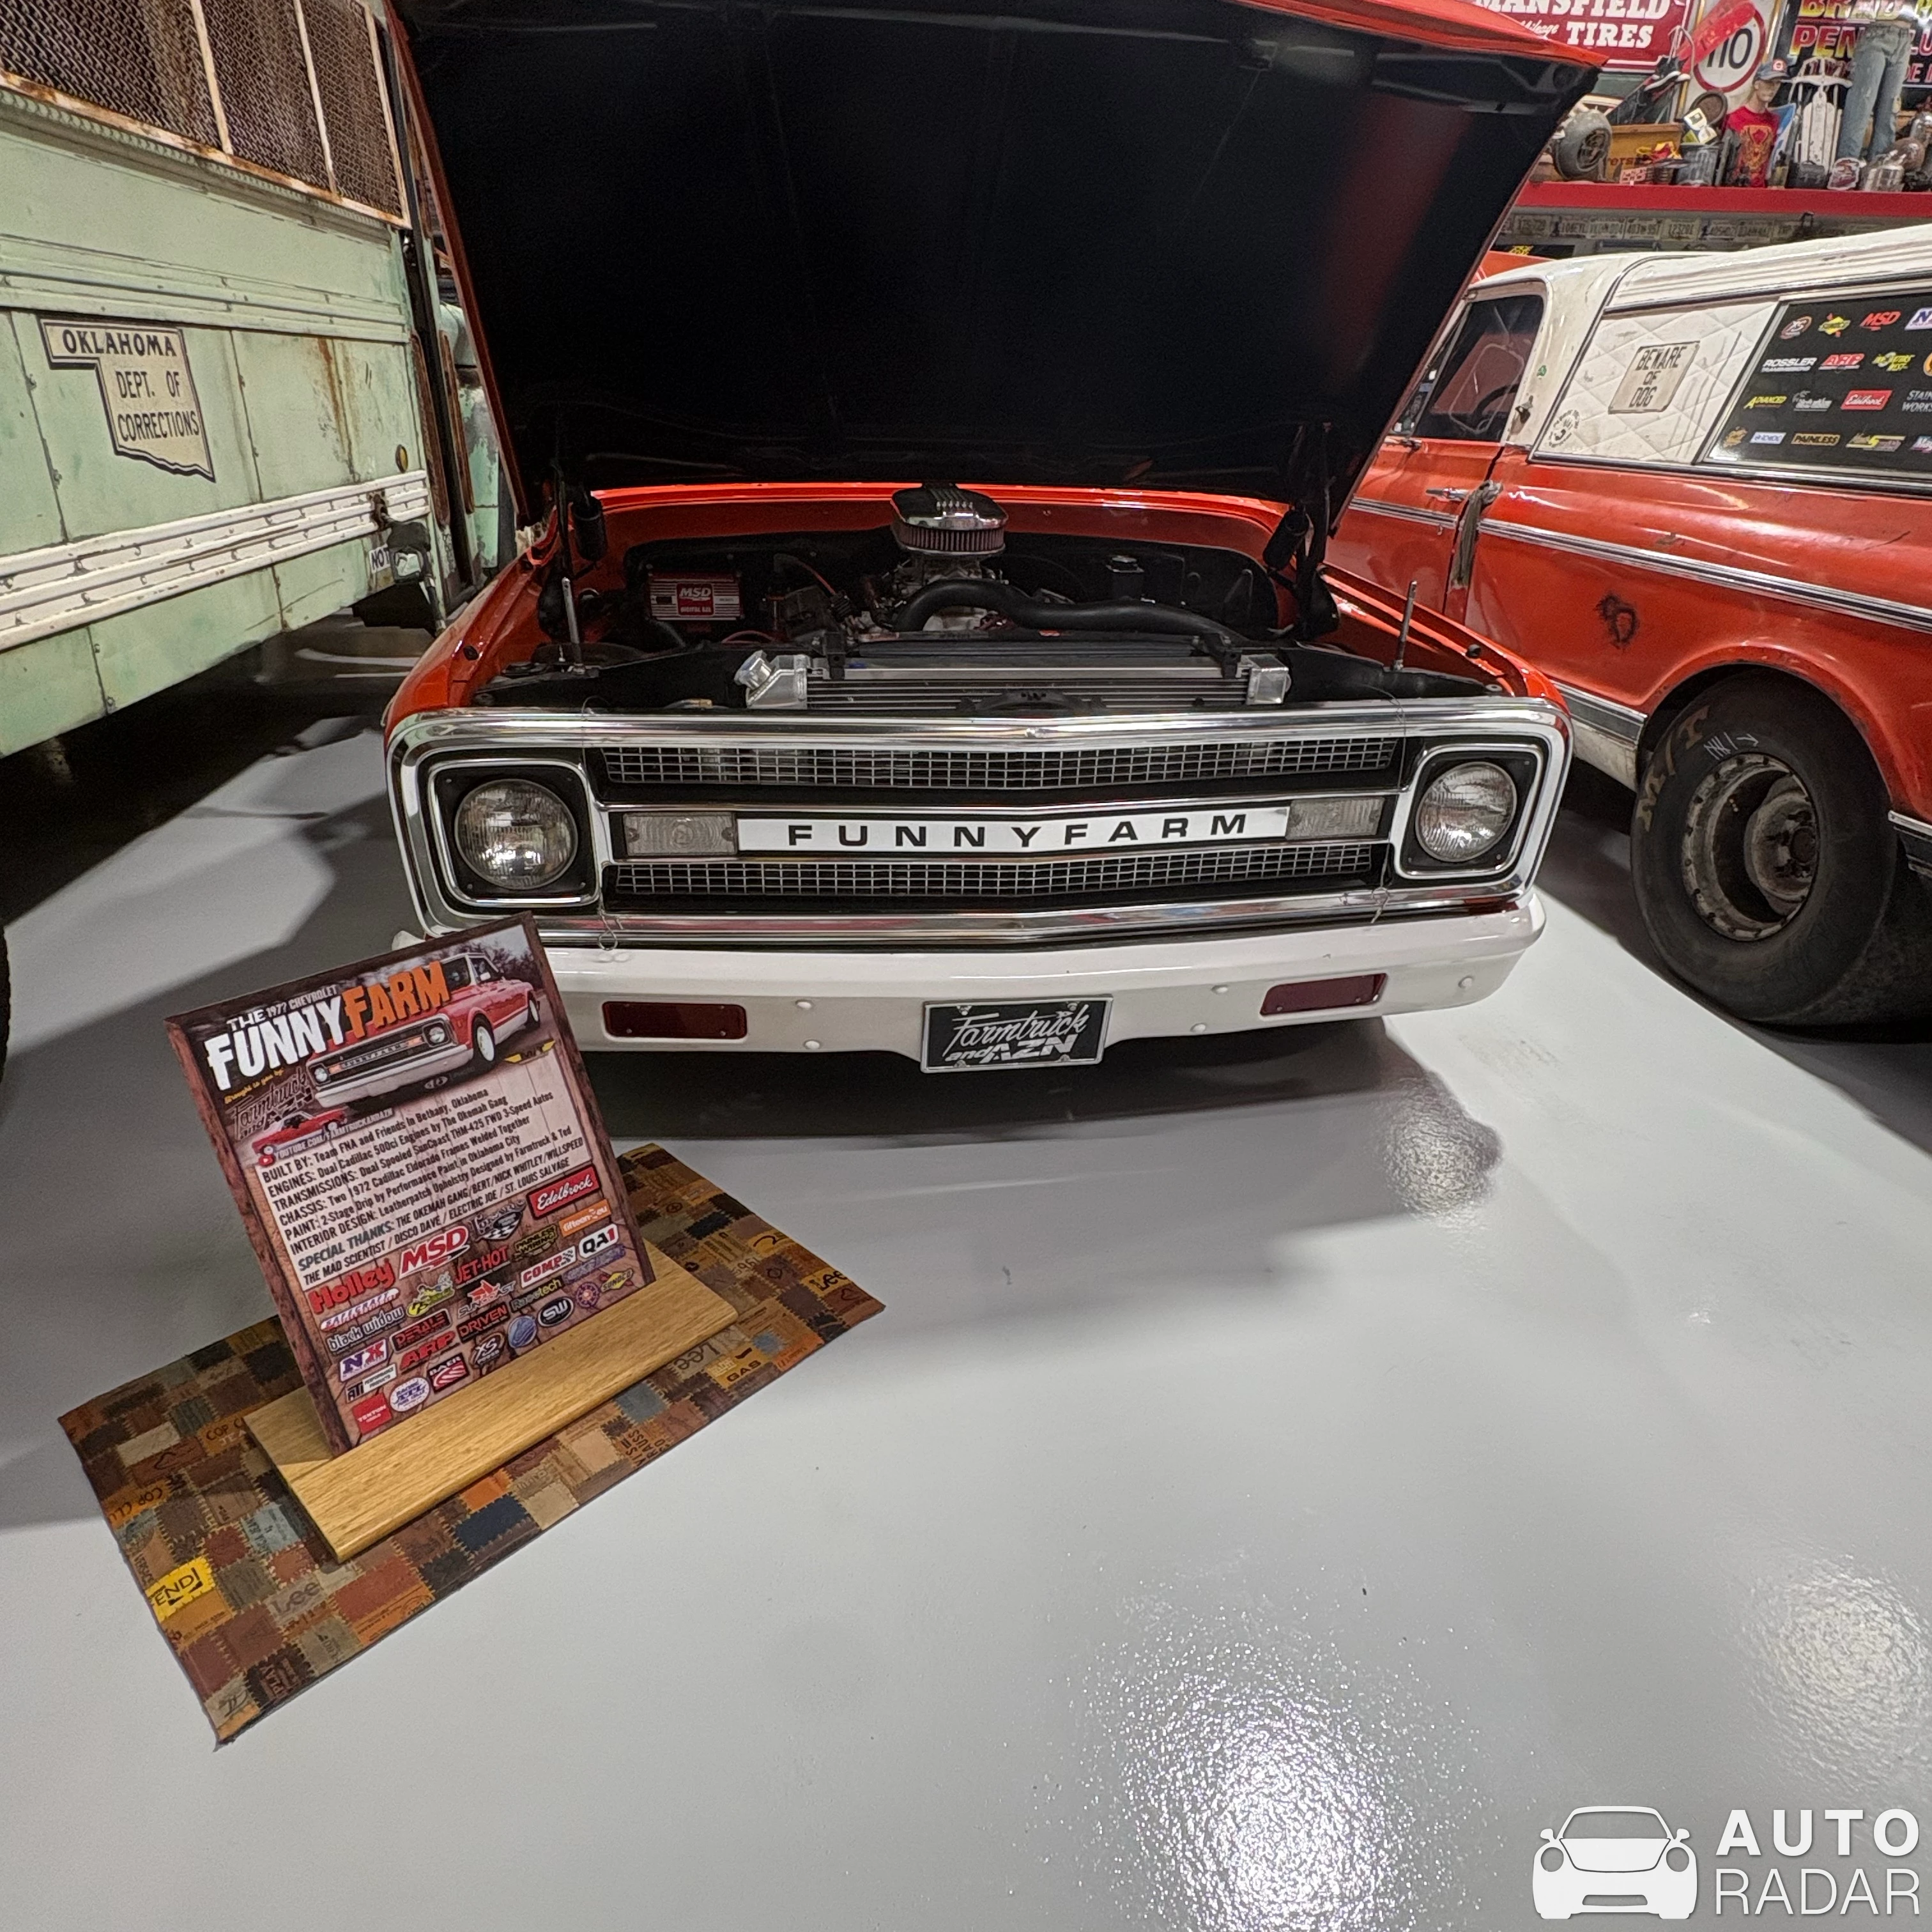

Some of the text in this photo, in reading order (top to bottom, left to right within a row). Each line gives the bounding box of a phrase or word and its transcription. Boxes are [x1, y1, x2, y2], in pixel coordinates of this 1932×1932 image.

[1567, 21, 1653, 48] TIRES
[1862, 311, 1901, 326] MSD
[63, 329, 177, 356] OKLAHOMA
[1636, 346, 1687, 371] BEWARE
[1762, 356, 1818, 367] ROSSLER
[1821, 353, 1865, 365] ARP
[116, 371, 180, 399] DEPT. OF
[1643, 371, 1661, 385] OF
[1629, 387, 1657, 408] DOG
[118, 411, 199, 442] CORRECTIONS
[1793, 435, 1839, 445] PAINLESS
[679, 587, 712, 597] MSD
[226, 1009, 266, 1031] THE
[289, 985, 339, 1009] CHEVROLET
[204, 960, 450, 1091] FUNNY FARM
[942, 1004, 1090, 1057] Farmtruck
[261, 1162, 294, 1184] BUILT
[293, 1154, 313, 1171] BY:
[312, 1145, 339, 1163] Team
[338, 1137, 358, 1153] FNA
[356, 1131, 375, 1146] and
[374, 1118, 406, 1139] Friends
[415, 1101, 452, 1125] Bethany,
[450, 1086, 489, 1109] Oklahoma
[266, 1169, 317, 1198] ENGINES:
[316, 1162, 338, 1178] Dual
[337, 1147, 373, 1170] Cadillac
[398, 1124, 431, 1147] Engines
[429, 1120, 442, 1135] by
[441, 1114, 457, 1128] The
[456, 1101, 487, 1121] Okemah
[487, 1094, 509, 1111] Gang
[272, 1089, 554, 1213] TRANSMISSIONS: Dual Spooled SunCoast THM-425 FWD 3-Speed Autos
[278, 1114, 532, 1227] CHASSIS: Two 1972 Cadillac Eldorado Frames Welded Together
[284, 1132, 521, 1241] PAINT: 2-Stage Drip by Performance Paint in Oklahoma City
[289, 1225, 338, 1255] INTERIOR
[337, 1208, 378, 1234] DESIGN:
[377, 1185, 433, 1218] Leatherpatch
[469, 1154, 505, 1179] Designed
[503, 1149, 516, 1163] by
[514, 1134, 551, 1157] Farmtruck
[550, 1131, 558, 1142] &
[557, 1124, 572, 1138] Ted
[537, 1176, 592, 1210] Edelbrock
[296, 1241, 346, 1272] SPECIAL
[346, 1218, 396, 1250] THANKS:
[395, 1212, 413, 1228] THE
[411, 1197, 447, 1220] OKEMAH
[303, 1268, 323, 1285] THE
[320, 1259, 343, 1277] MAD
[342, 1239, 387, 1268] SCIENTIST
[392, 1225, 419, 1245] DISCO
[418, 1215, 442, 1233] DAVE
[447, 1195, 484, 1220] ELECTRIC
[482, 1189, 499, 1204] JOE
[503, 1181, 517, 1194] ST.
[516, 1170, 539, 1188] LOUIS
[537, 1156, 571, 1179] SALVAGE
[401, 1225, 467, 1274] MSD
[583, 1228, 615, 1254] QA1
[455, 1246, 509, 1284] JET-HOT
[523, 1255, 562, 1282] COMP
[308, 1257, 395, 1314] Holley
[328, 1301, 404, 1351] black widow
[459, 1304, 507, 1336] DRIVEN
[543, 1300, 568, 1321] SW
[395, 1313, 444, 1343] DERALE
[342, 1343, 385, 1375] NX
[399, 1331, 456, 1369] ARP
[430, 1356, 460, 1375] BAER
[477, 1338, 498, 1362] XS
[674, 1342, 721, 1371] Lee
[726, 1360, 761, 1382] GAS
[207, 1426, 230, 1440] COP
[139, 1487, 164, 1505] COP
[272, 1581, 324, 1616] Lee
